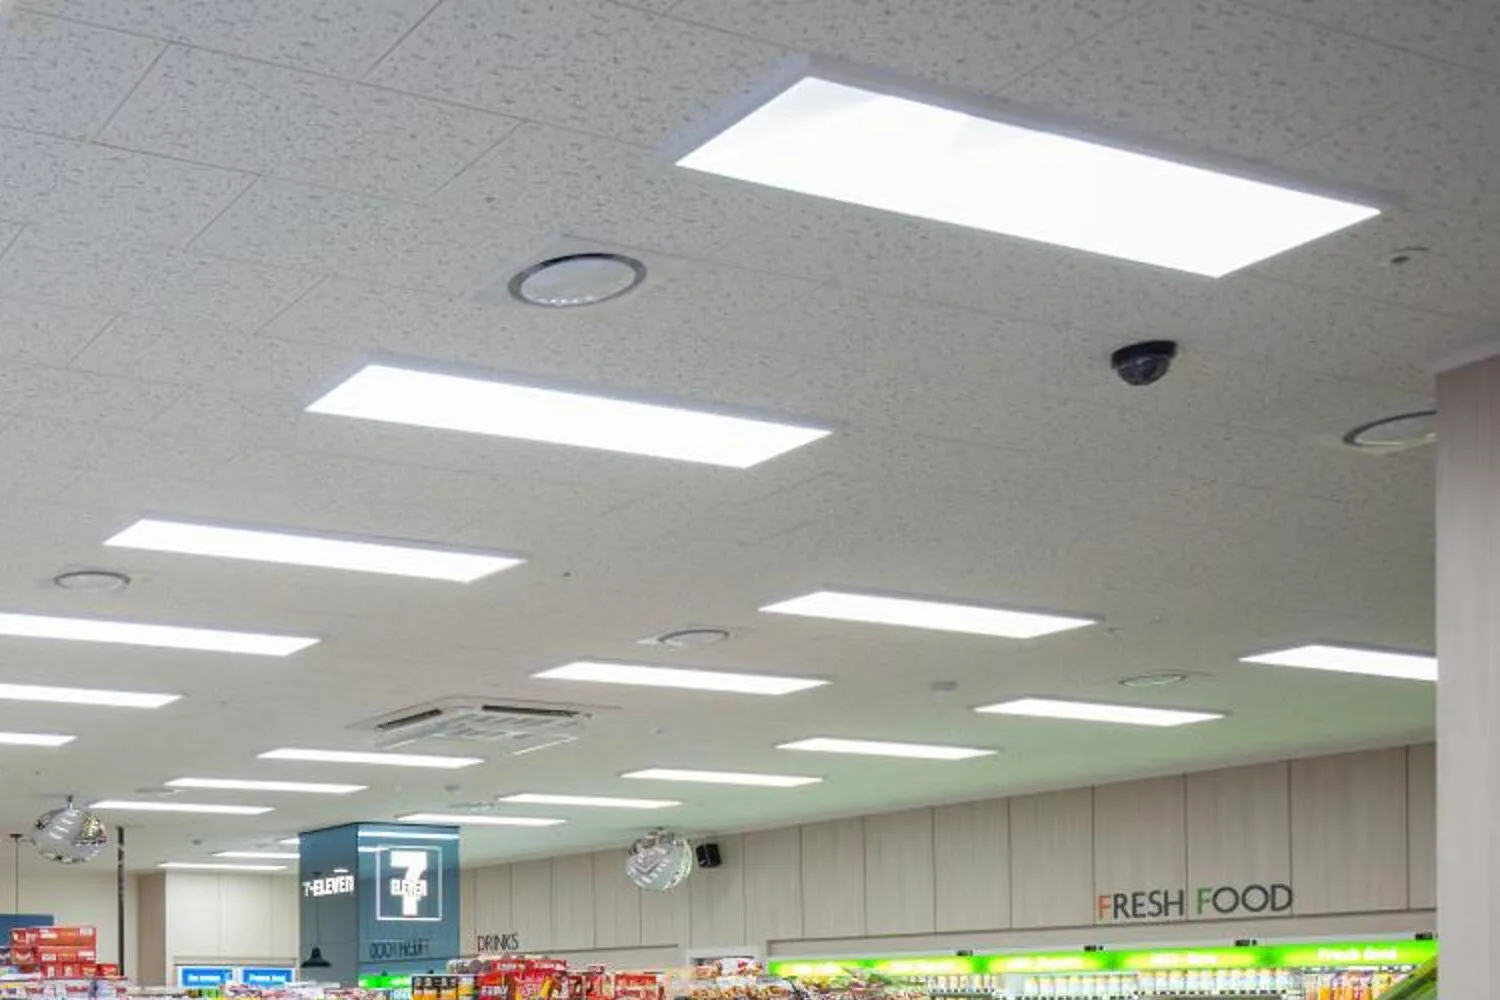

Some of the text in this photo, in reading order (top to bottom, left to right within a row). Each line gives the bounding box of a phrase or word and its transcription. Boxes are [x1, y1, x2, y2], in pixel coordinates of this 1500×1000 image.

[1098, 884, 1293, 920] FRESH FOOD
[477, 932, 519, 952] DRINKS
